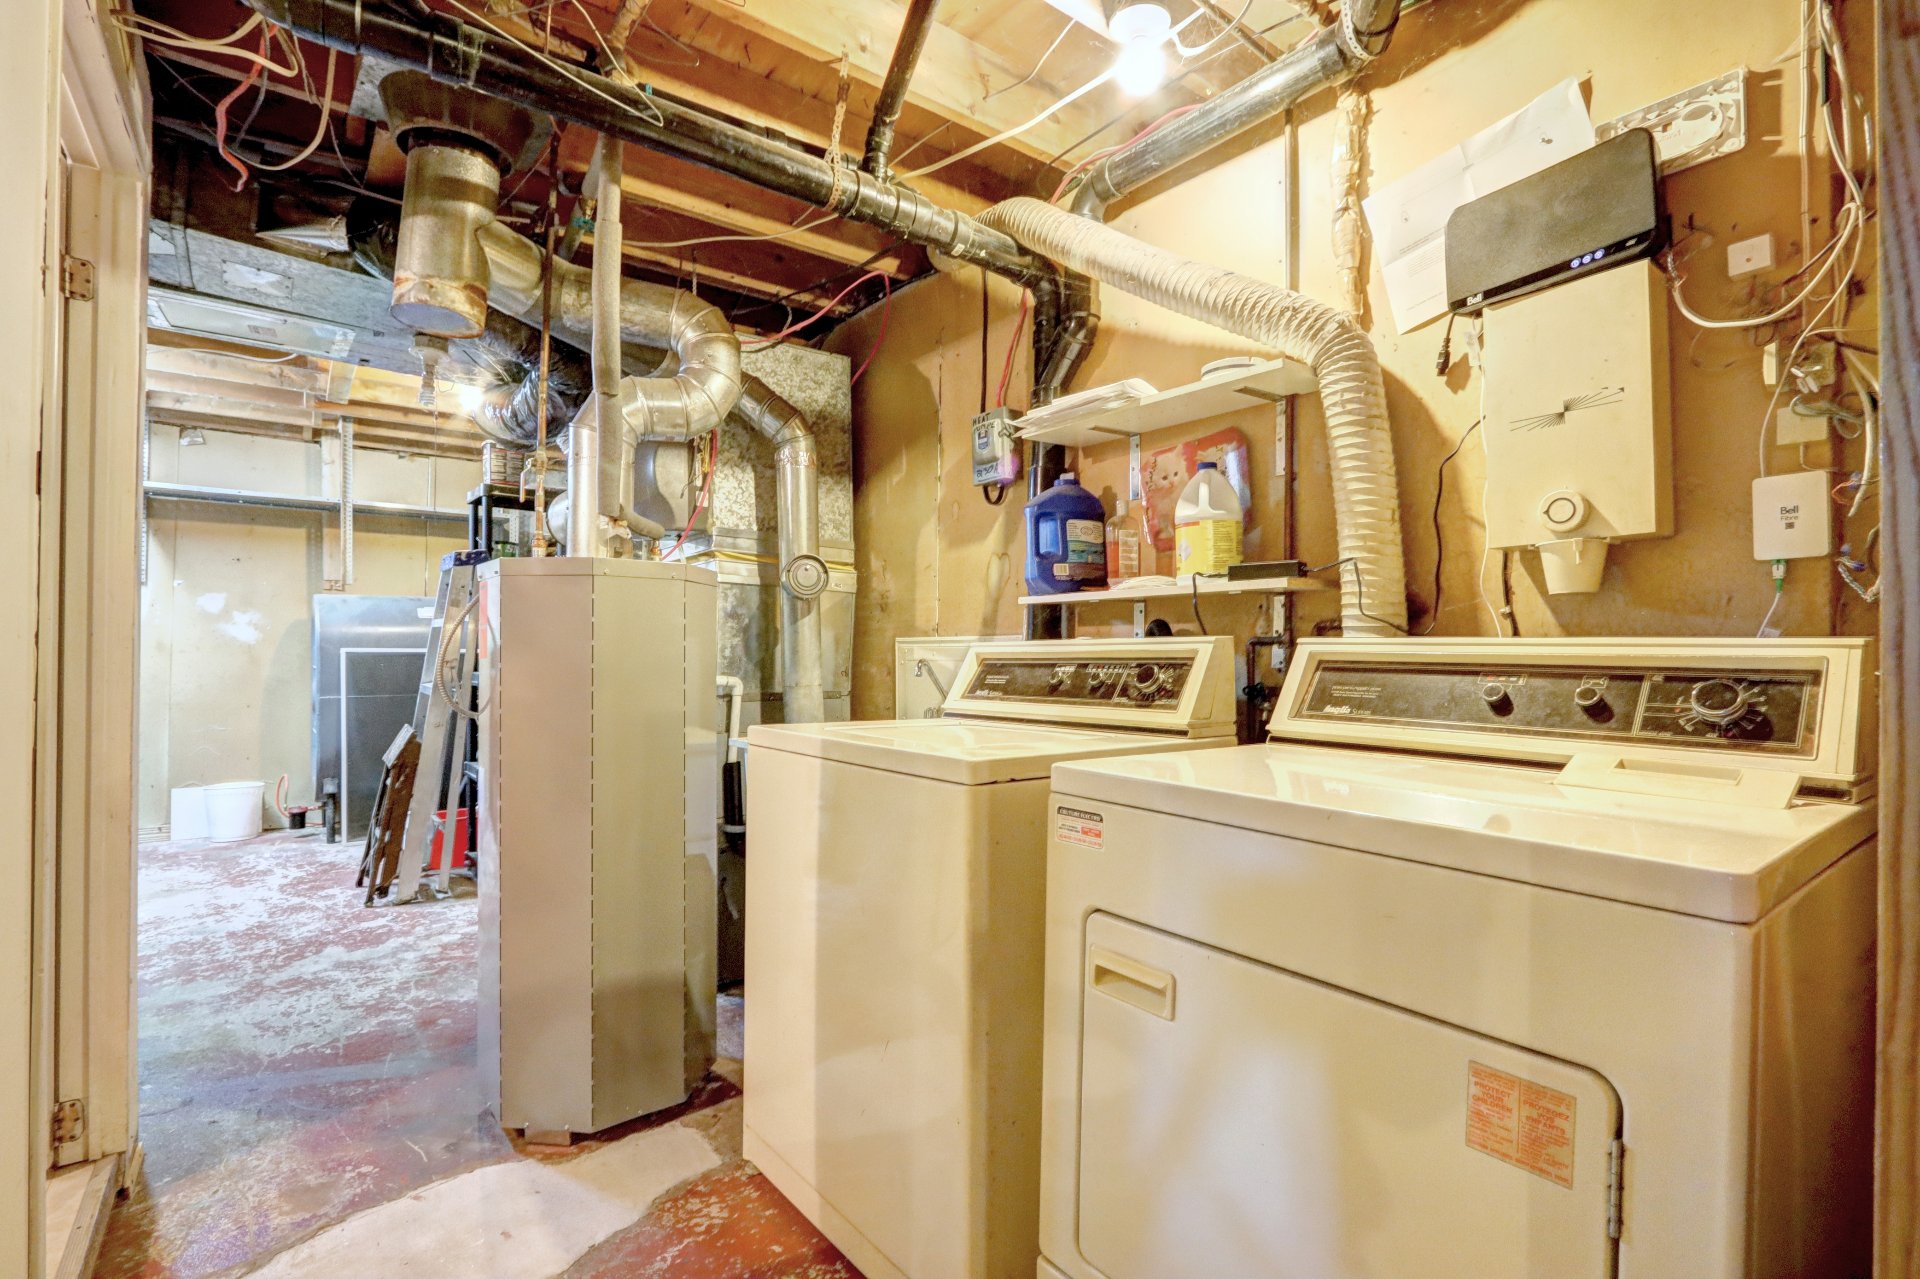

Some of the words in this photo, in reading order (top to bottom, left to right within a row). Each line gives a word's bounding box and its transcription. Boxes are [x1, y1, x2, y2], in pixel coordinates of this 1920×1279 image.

[1467, 293, 1482, 306] Bell
[1780, 505, 1799, 515] Bell
[1474, 1080, 1511, 1100] PROTECT
[1481, 1090, 1504, 1104] YOUR
[1472, 1094, 1513, 1114] CHILDREN
